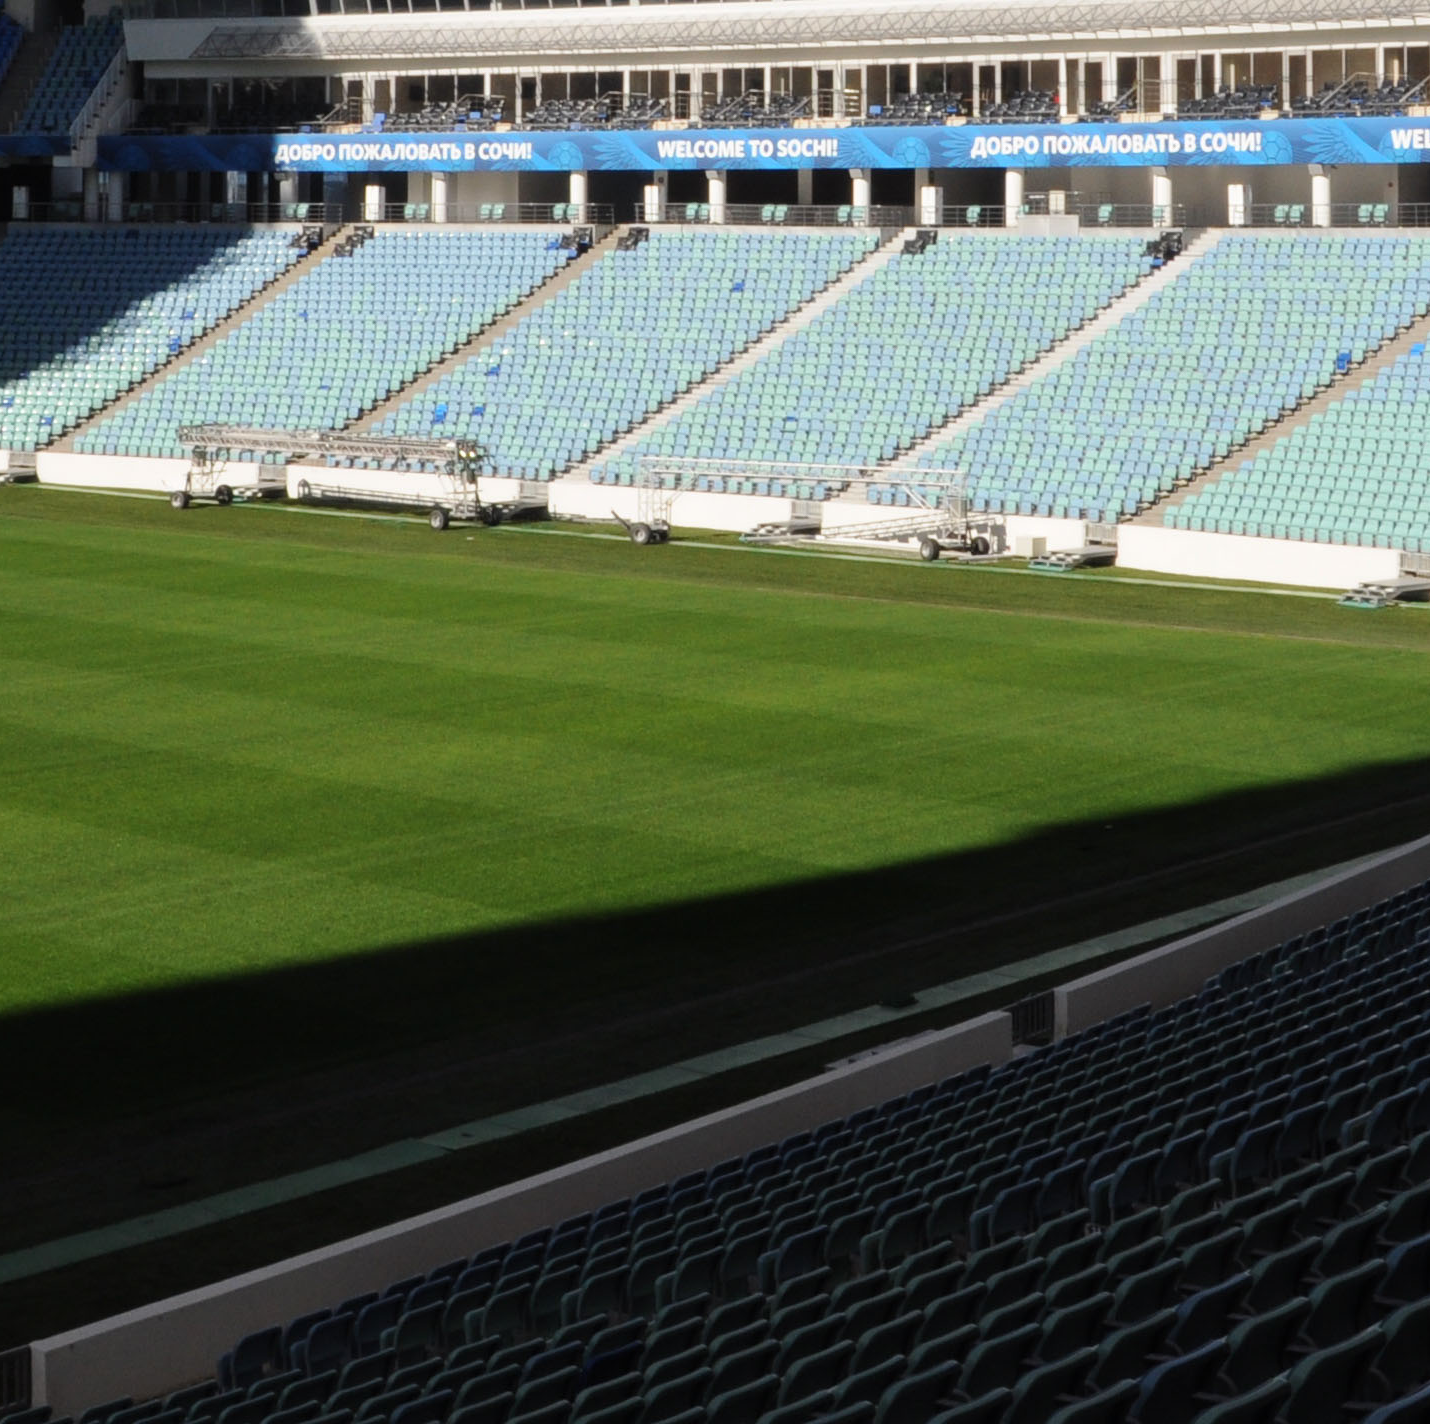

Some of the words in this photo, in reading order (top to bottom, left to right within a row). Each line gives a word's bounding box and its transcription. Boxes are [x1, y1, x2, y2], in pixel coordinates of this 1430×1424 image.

[275, 143, 335, 164] ДОБРО
[339, 143, 461, 161] ПОЖАЛОВАТЬ
[464, 143, 476, 160] В
[478, 142, 532, 160] СОЧИ!
[657, 140, 745, 158] WELCOME
[748, 140, 774, 157] TO
[777, 139, 838, 157] SOCHI!
[970, 135, 1039, 158] ДОБРО
[1043, 133, 1180, 154] ПОЖАЛОВАТЬ
[1184, 133, 1197, 152] В
[1199, 132, 1262, 152] СОЧИ!
